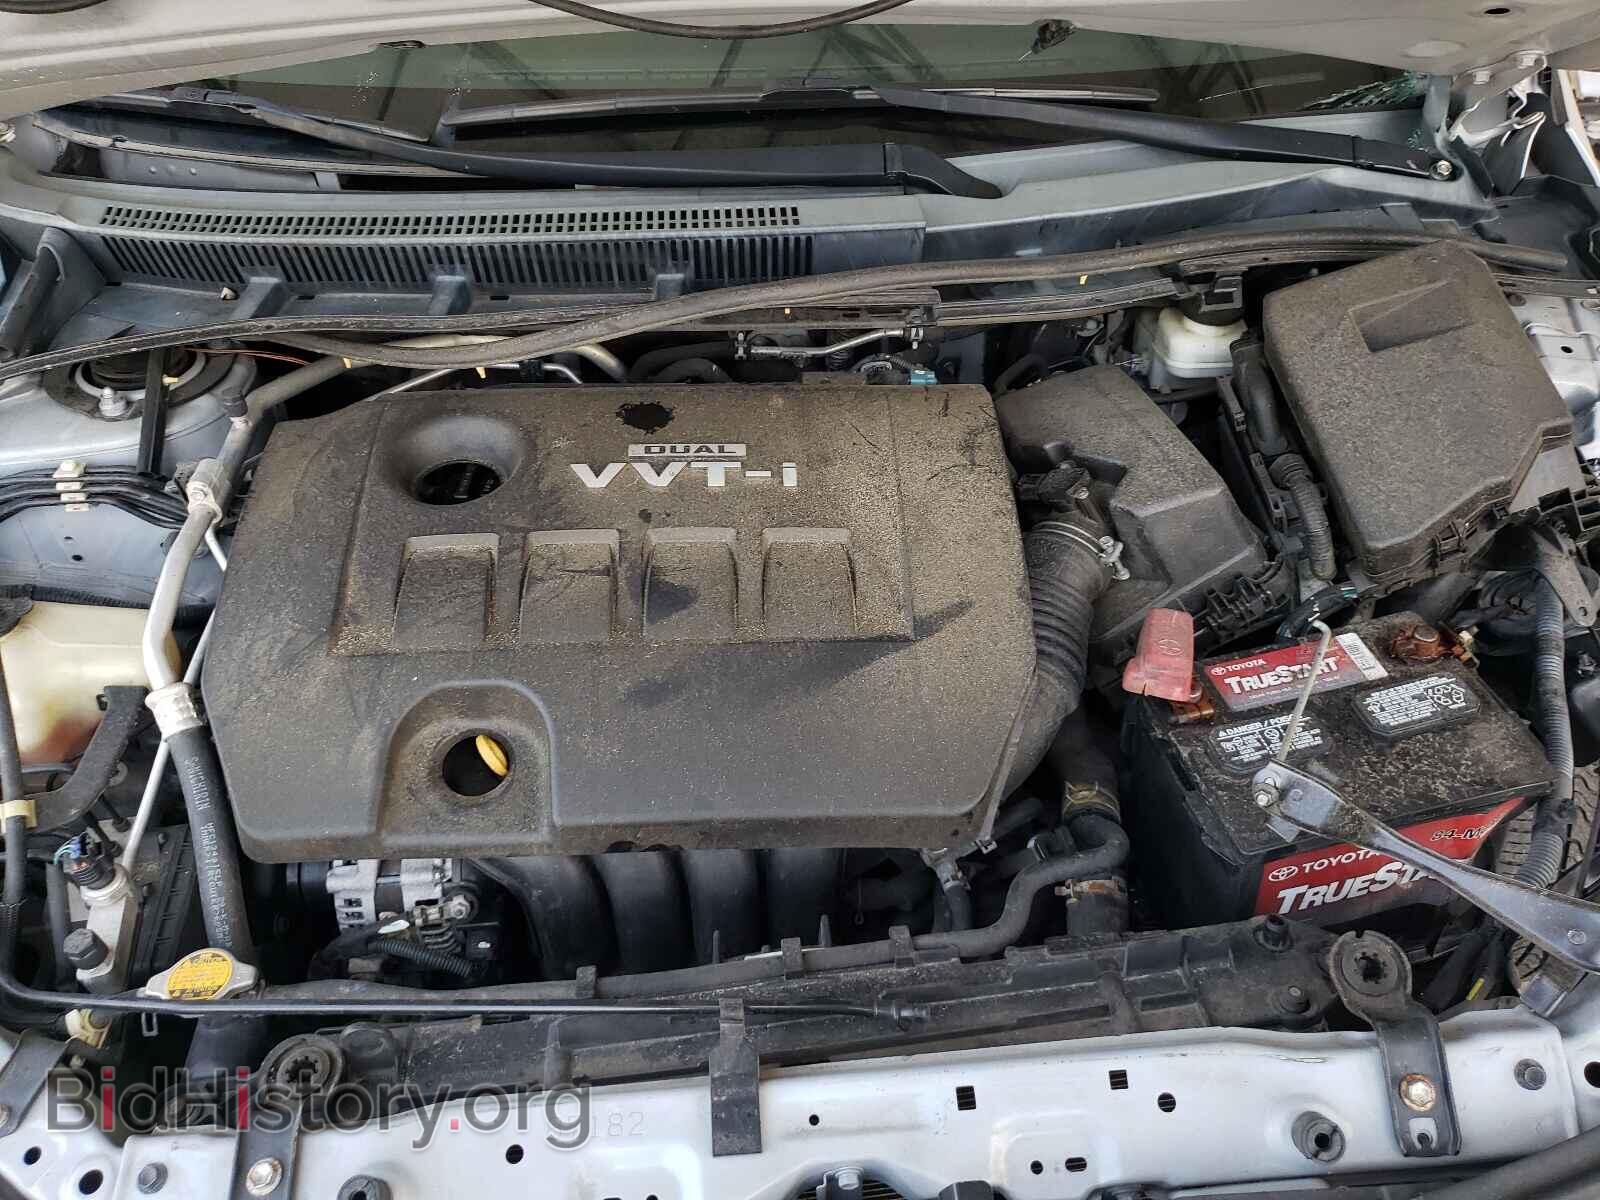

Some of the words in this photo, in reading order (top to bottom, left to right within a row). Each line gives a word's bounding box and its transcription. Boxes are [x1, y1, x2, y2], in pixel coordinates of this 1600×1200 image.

[642, 444, 738, 455] DUAL
[570, 461, 798, 487] VVT-i
[1227, 658, 1267, 672] TOYOTA
[1226, 721, 1263, 735] DANGER
